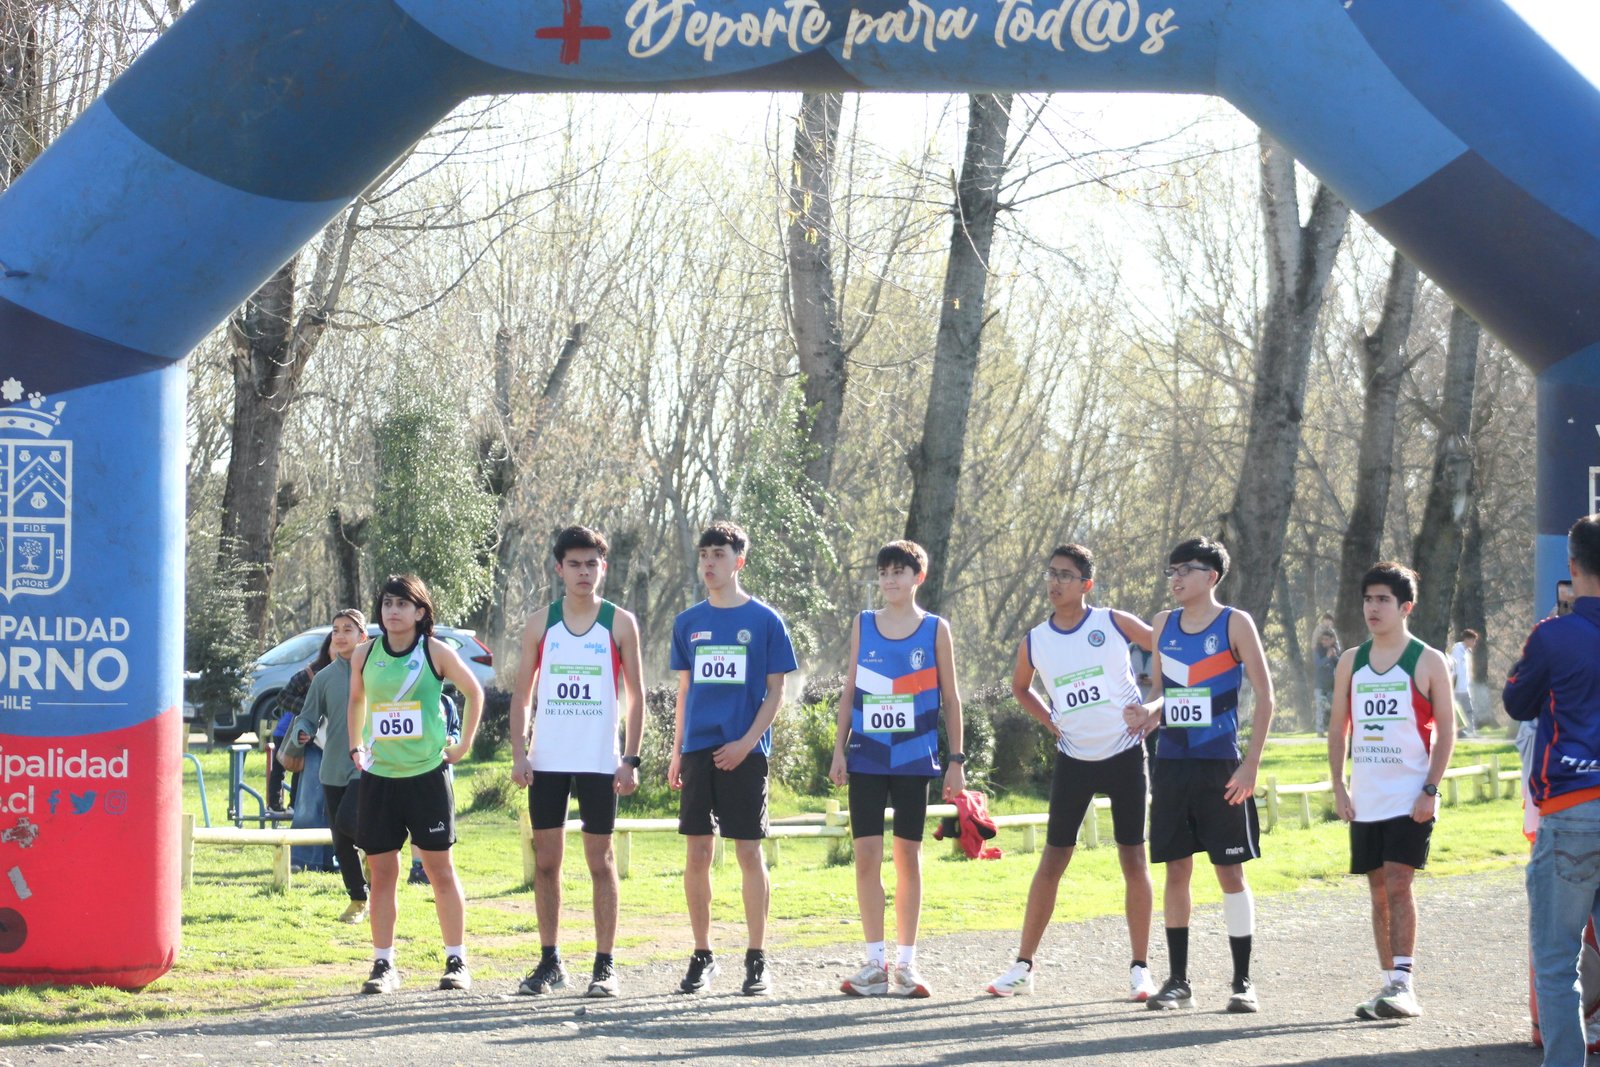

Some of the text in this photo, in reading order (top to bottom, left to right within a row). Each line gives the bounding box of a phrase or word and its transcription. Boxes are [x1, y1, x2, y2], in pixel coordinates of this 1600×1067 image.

[625, 0, 831, 61] Deporte
[842, 0, 978, 59] para
[23, 524, 47, 532] FIDE
[55, 548, 64, 561] ET
[15, 579, 49, 588] AMORE
[0, 646, 129, 692] RNO
[702, 662, 737, 678] 004
[557, 682, 592, 699] 001
[1066, 685, 1101, 707] 003
[1170, 705, 1202, 722] 005
[1364, 698, 1398, 716] 002
[379, 718, 414, 735] 050
[871, 711, 906, 729] 006
[0, 785, 35, 814] .cl
[1225, 846, 1245, 855] mitre
